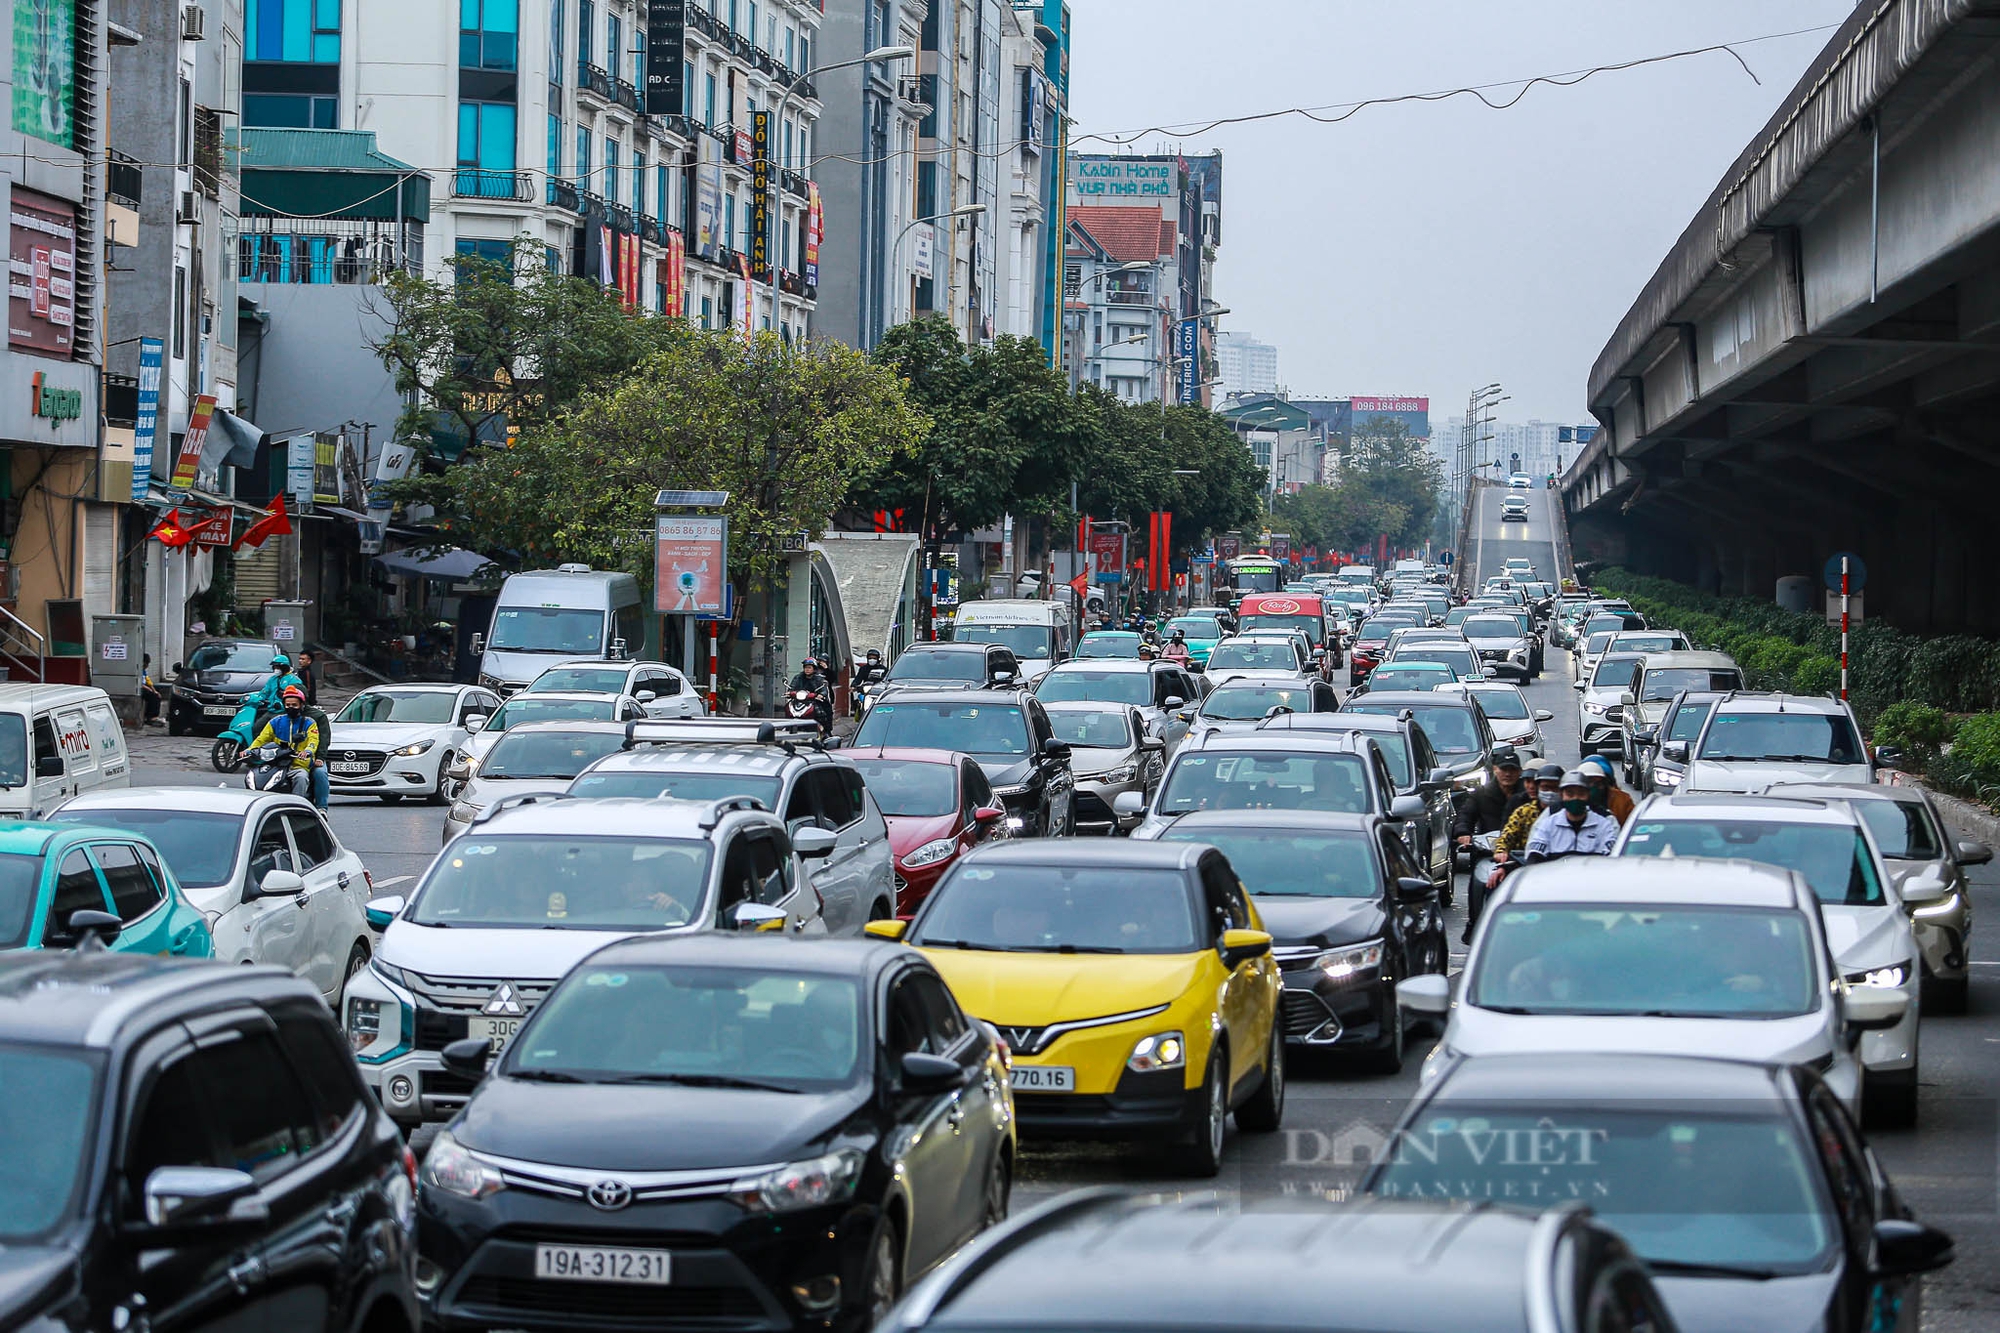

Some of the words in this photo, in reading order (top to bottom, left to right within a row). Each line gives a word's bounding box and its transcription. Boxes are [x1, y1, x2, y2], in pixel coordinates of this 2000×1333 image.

[1127, 163, 1169, 178] Home
[754, 237, 765, 273] ANH
[1357, 402, 1374, 411] 096
[1377, 402, 1394, 411] 184
[1395, 402, 1418, 412] 6868
[660, 526, 680, 535] 0865
[682, 526, 694, 535] 86
[697, 526, 708, 535] 87
[710, 526, 721, 535] 86
